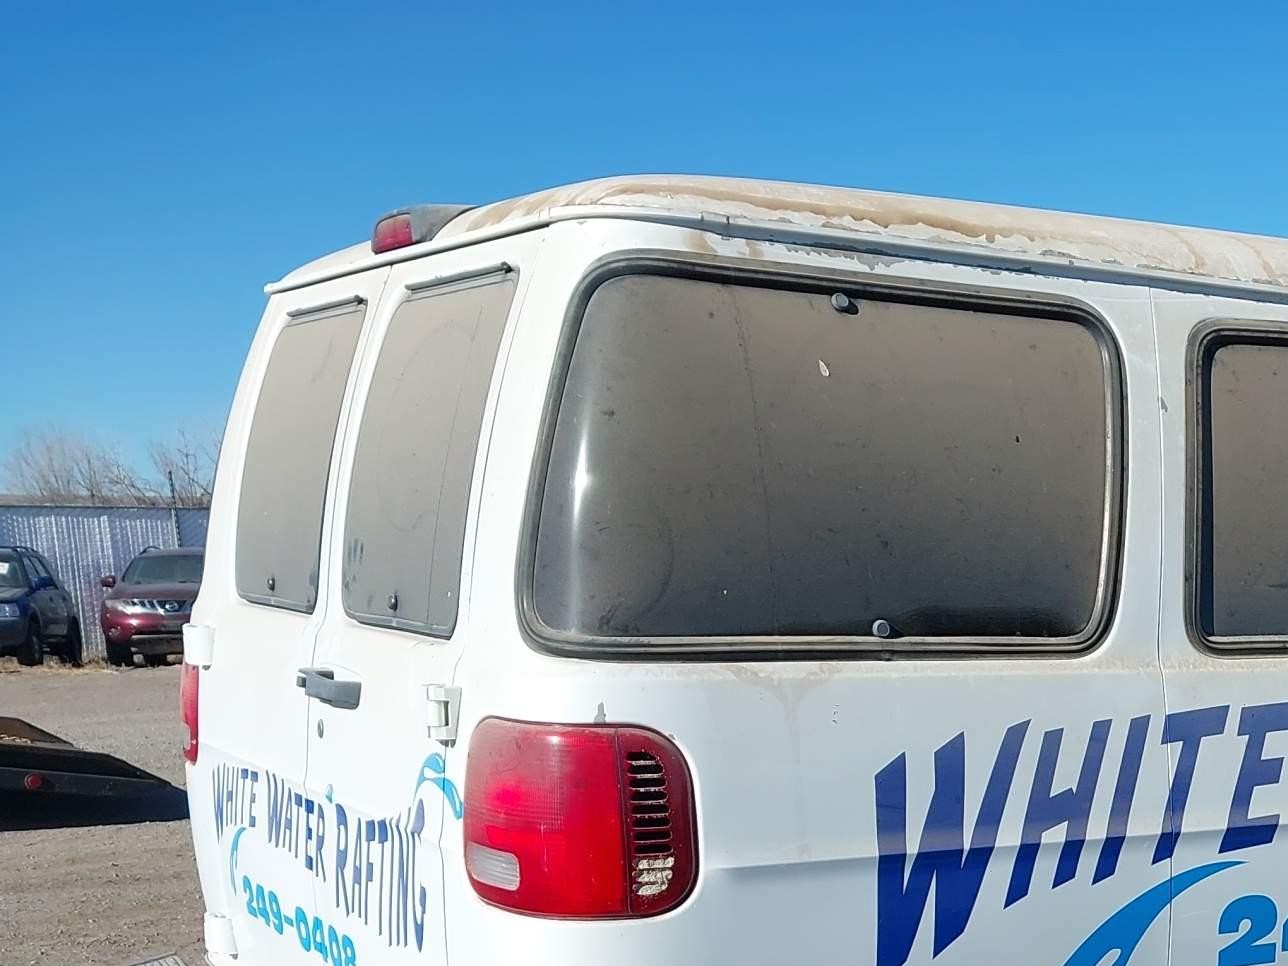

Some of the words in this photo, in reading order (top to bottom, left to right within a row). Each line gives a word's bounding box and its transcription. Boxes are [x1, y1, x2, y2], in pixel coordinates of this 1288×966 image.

[212, 762, 258, 844] WHITE
[265, 769, 326, 883] WATER
[335, 798, 427, 952] RAFTING
